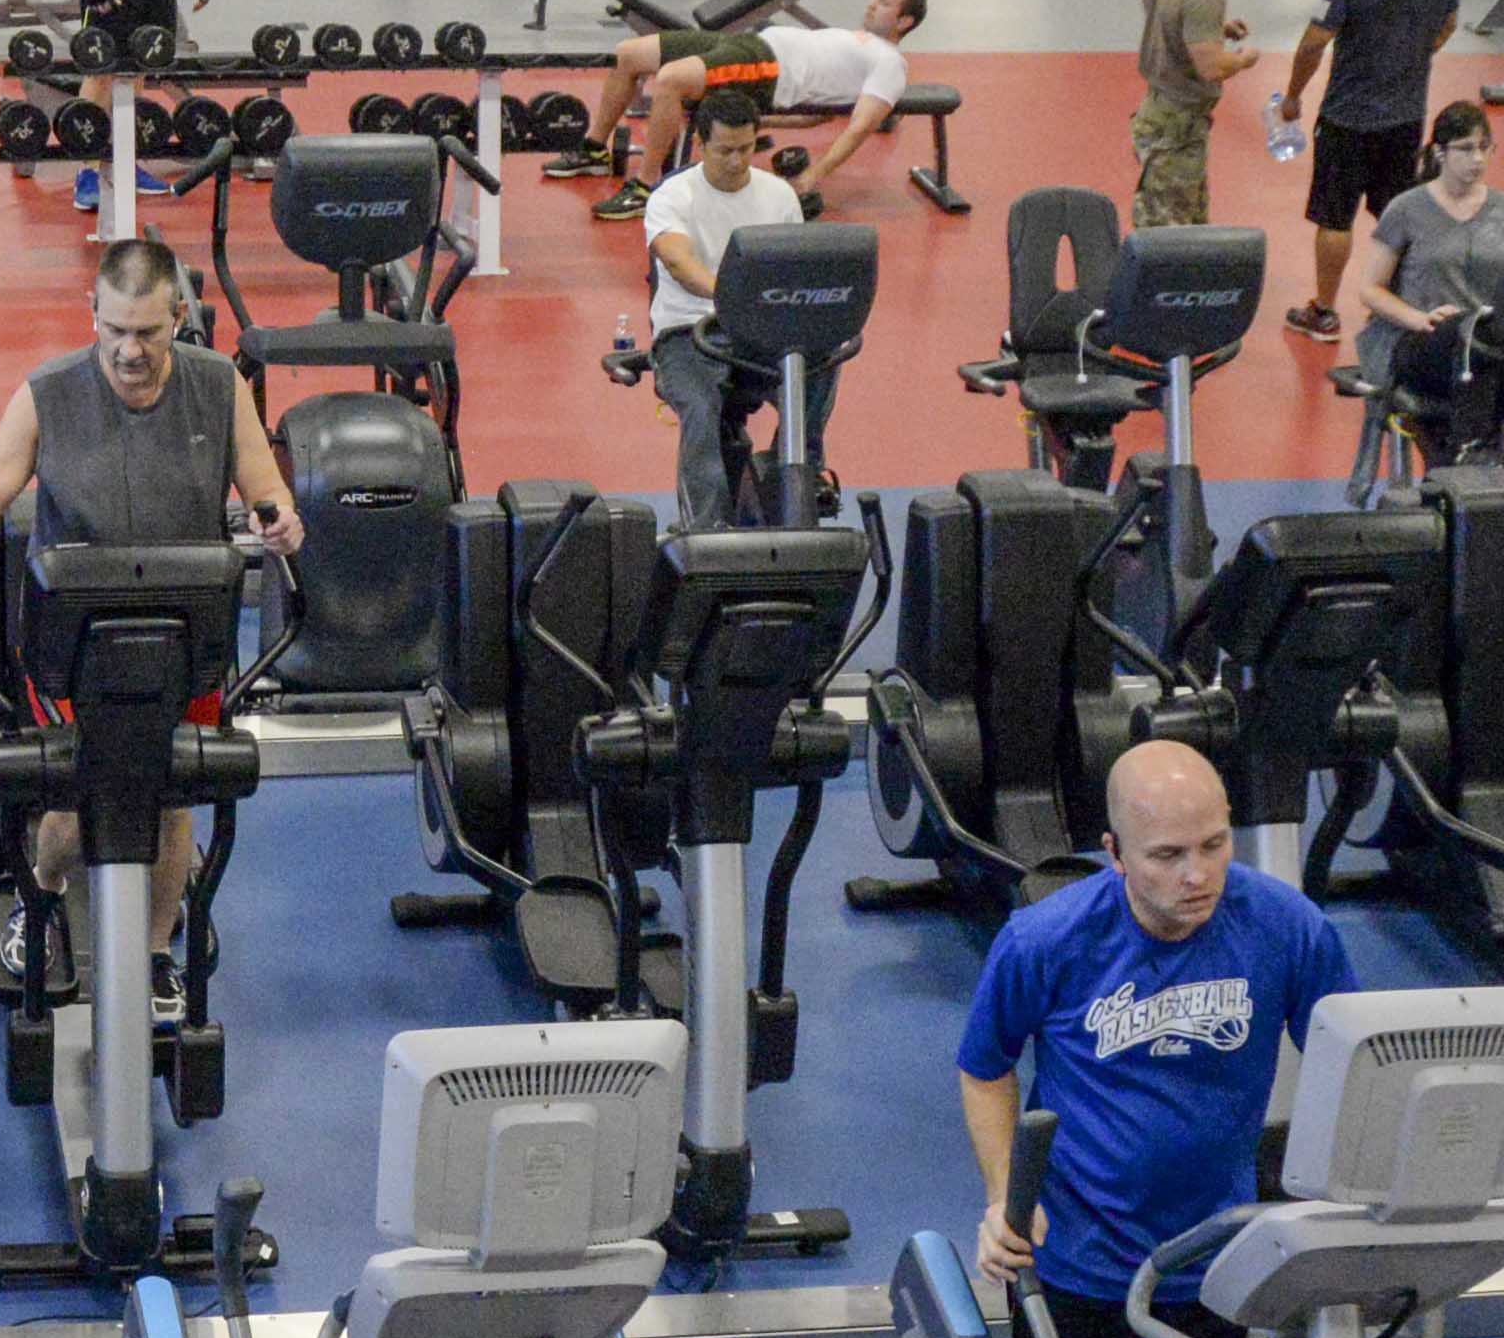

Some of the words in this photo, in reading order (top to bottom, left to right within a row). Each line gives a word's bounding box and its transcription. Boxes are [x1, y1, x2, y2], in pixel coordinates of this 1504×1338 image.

[344, 199, 412, 218] CYBEX
[790, 286, 853, 304] CYBEX
[339, 493, 374, 503] ARC
[1097, 978, 1252, 1054] BASKETBALL
